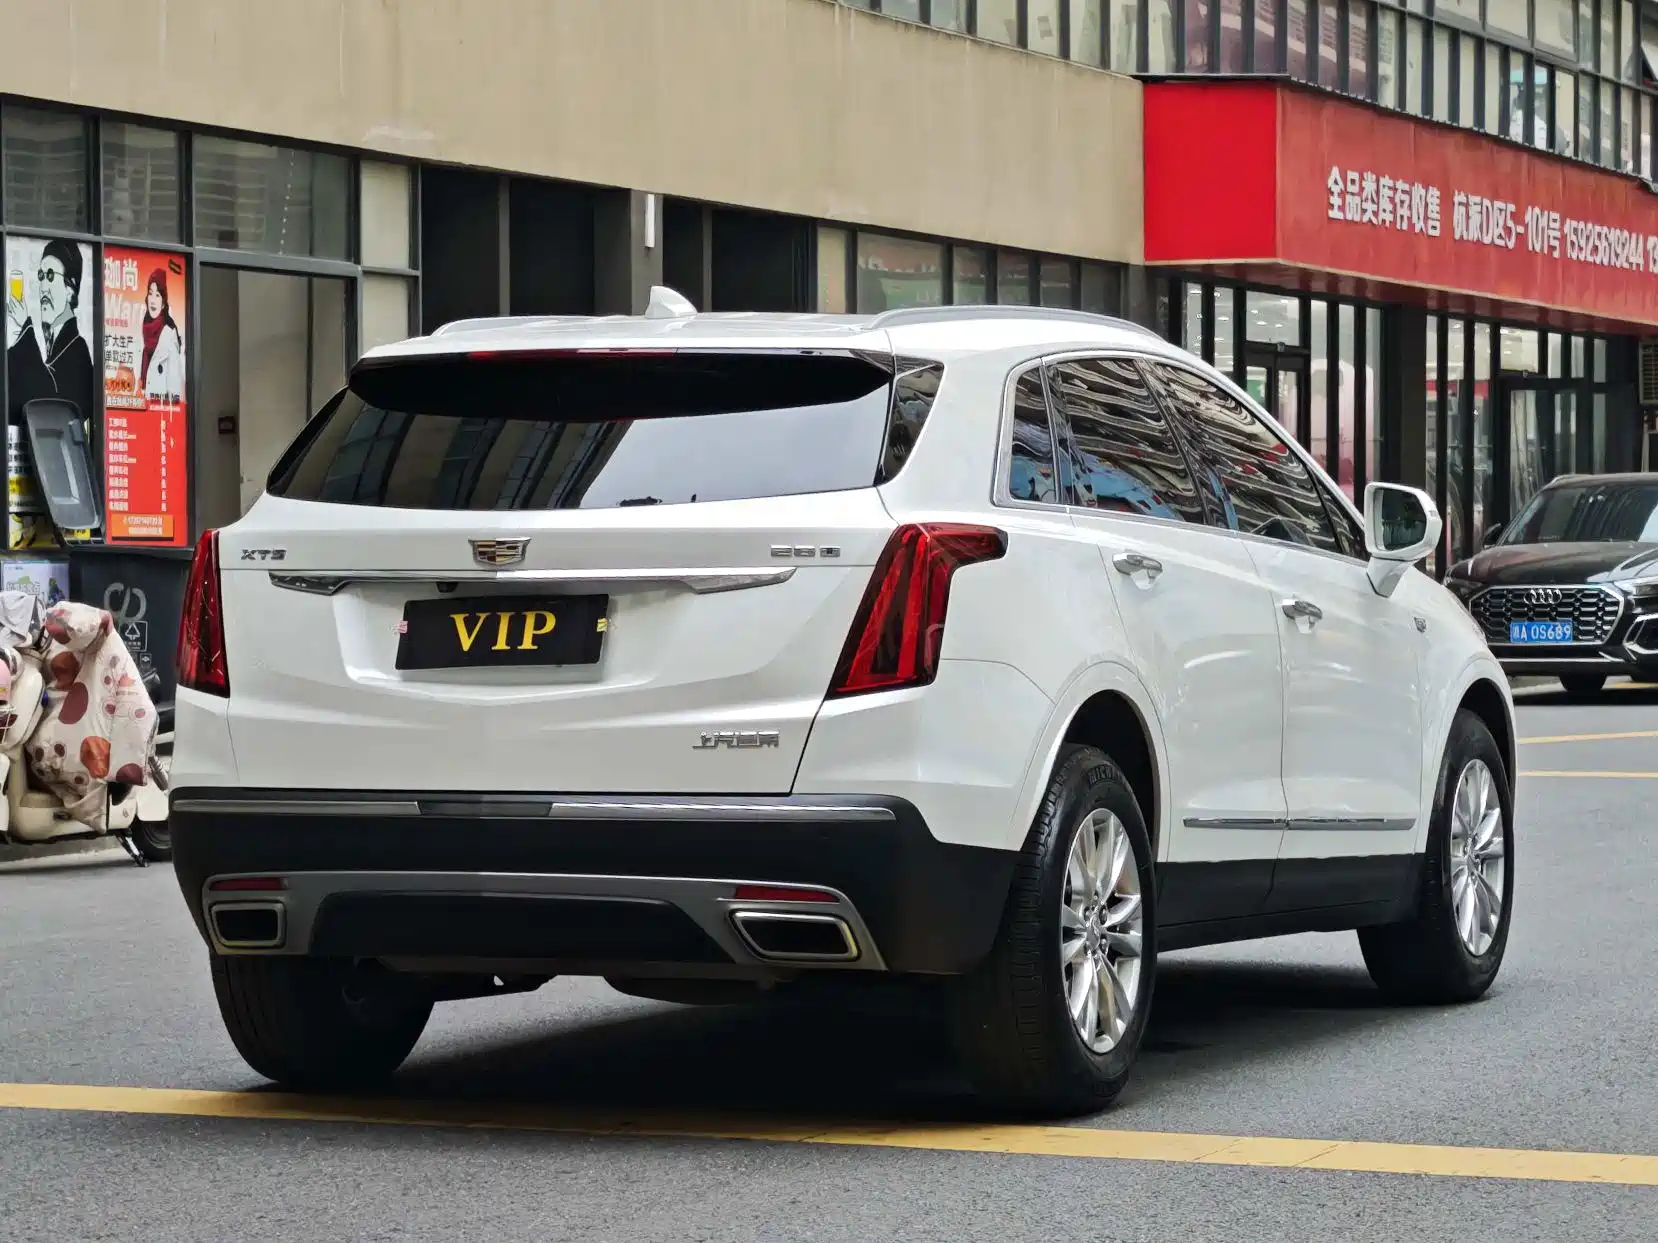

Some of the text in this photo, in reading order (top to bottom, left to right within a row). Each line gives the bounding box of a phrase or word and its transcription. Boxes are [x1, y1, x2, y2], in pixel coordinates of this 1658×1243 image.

[1327, 165, 1440, 237] 全品类库存收售
[449, 611, 556, 652] VIP
